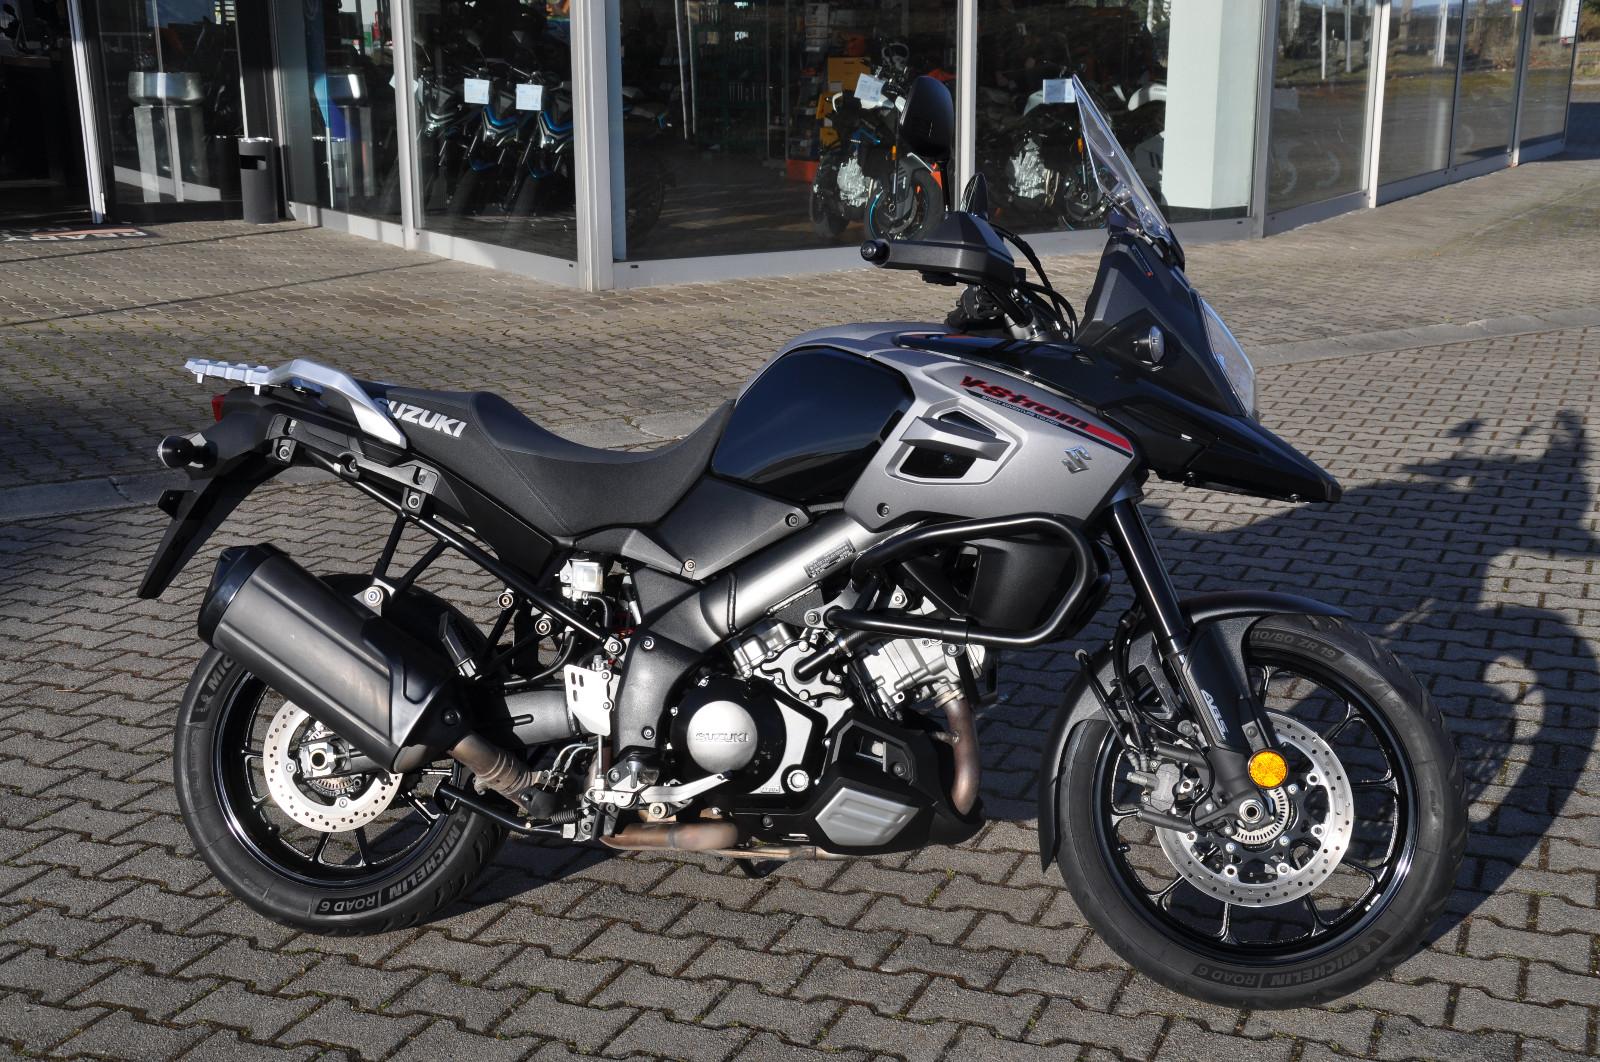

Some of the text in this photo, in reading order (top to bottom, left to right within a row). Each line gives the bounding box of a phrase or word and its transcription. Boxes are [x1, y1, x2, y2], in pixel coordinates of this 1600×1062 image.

[1297, 638, 1319, 651] ZR
[1320, 646, 1336, 659] 19
[1201, 689, 1228, 736] ABS
[695, 731, 749, 743] SUZUKI
[319, 825, 460, 912] MICHELIN ROAD 6
[1211, 971, 1257, 986] ROAD
[1271, 948, 1359, 986] MICHELIN
